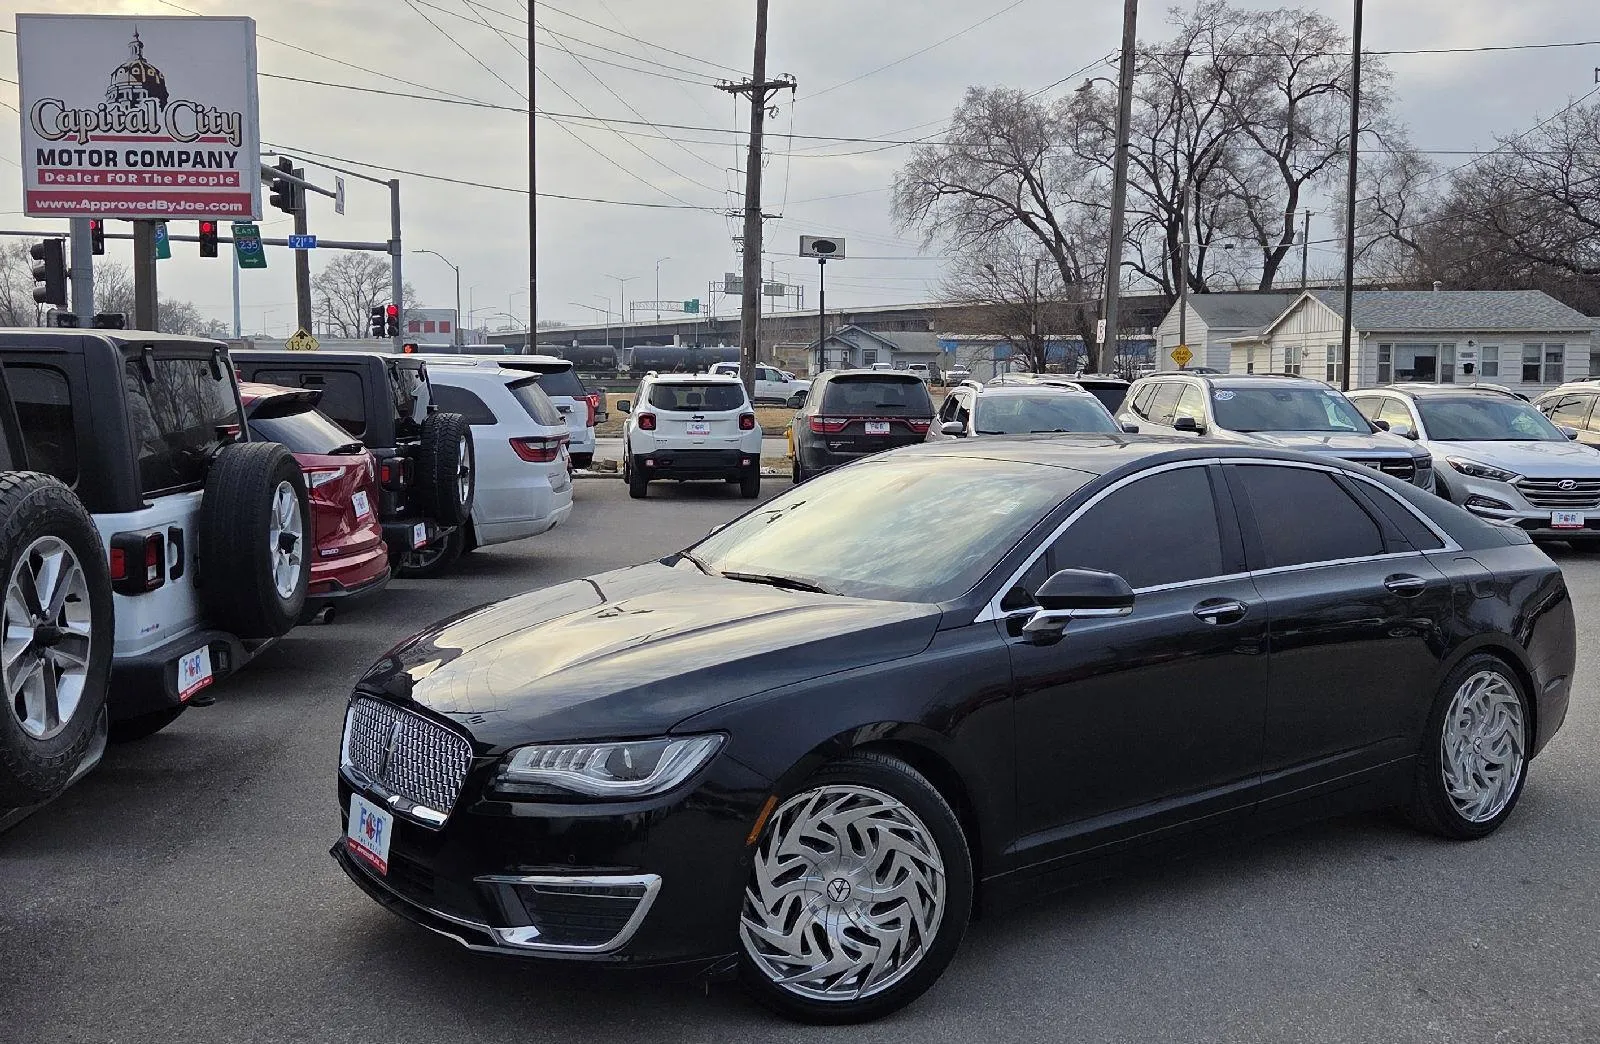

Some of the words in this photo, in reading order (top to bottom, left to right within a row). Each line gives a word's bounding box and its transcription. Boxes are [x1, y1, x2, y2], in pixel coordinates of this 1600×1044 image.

[30, 98, 161, 146] Capital
[164, 100, 242, 147] City
[36, 149, 118, 167] MOTOR
[125, 151, 238, 168] COMPANY
[44, 172, 100, 183] Dealer
[107, 173, 138, 183] FOR
[142, 173, 173, 184] The
[177, 174, 234, 186] People
[35, 199, 243, 212] www.ApprovedByJoe.com
[234, 226, 256, 235] EAST
[240, 240, 258, 249] 235
